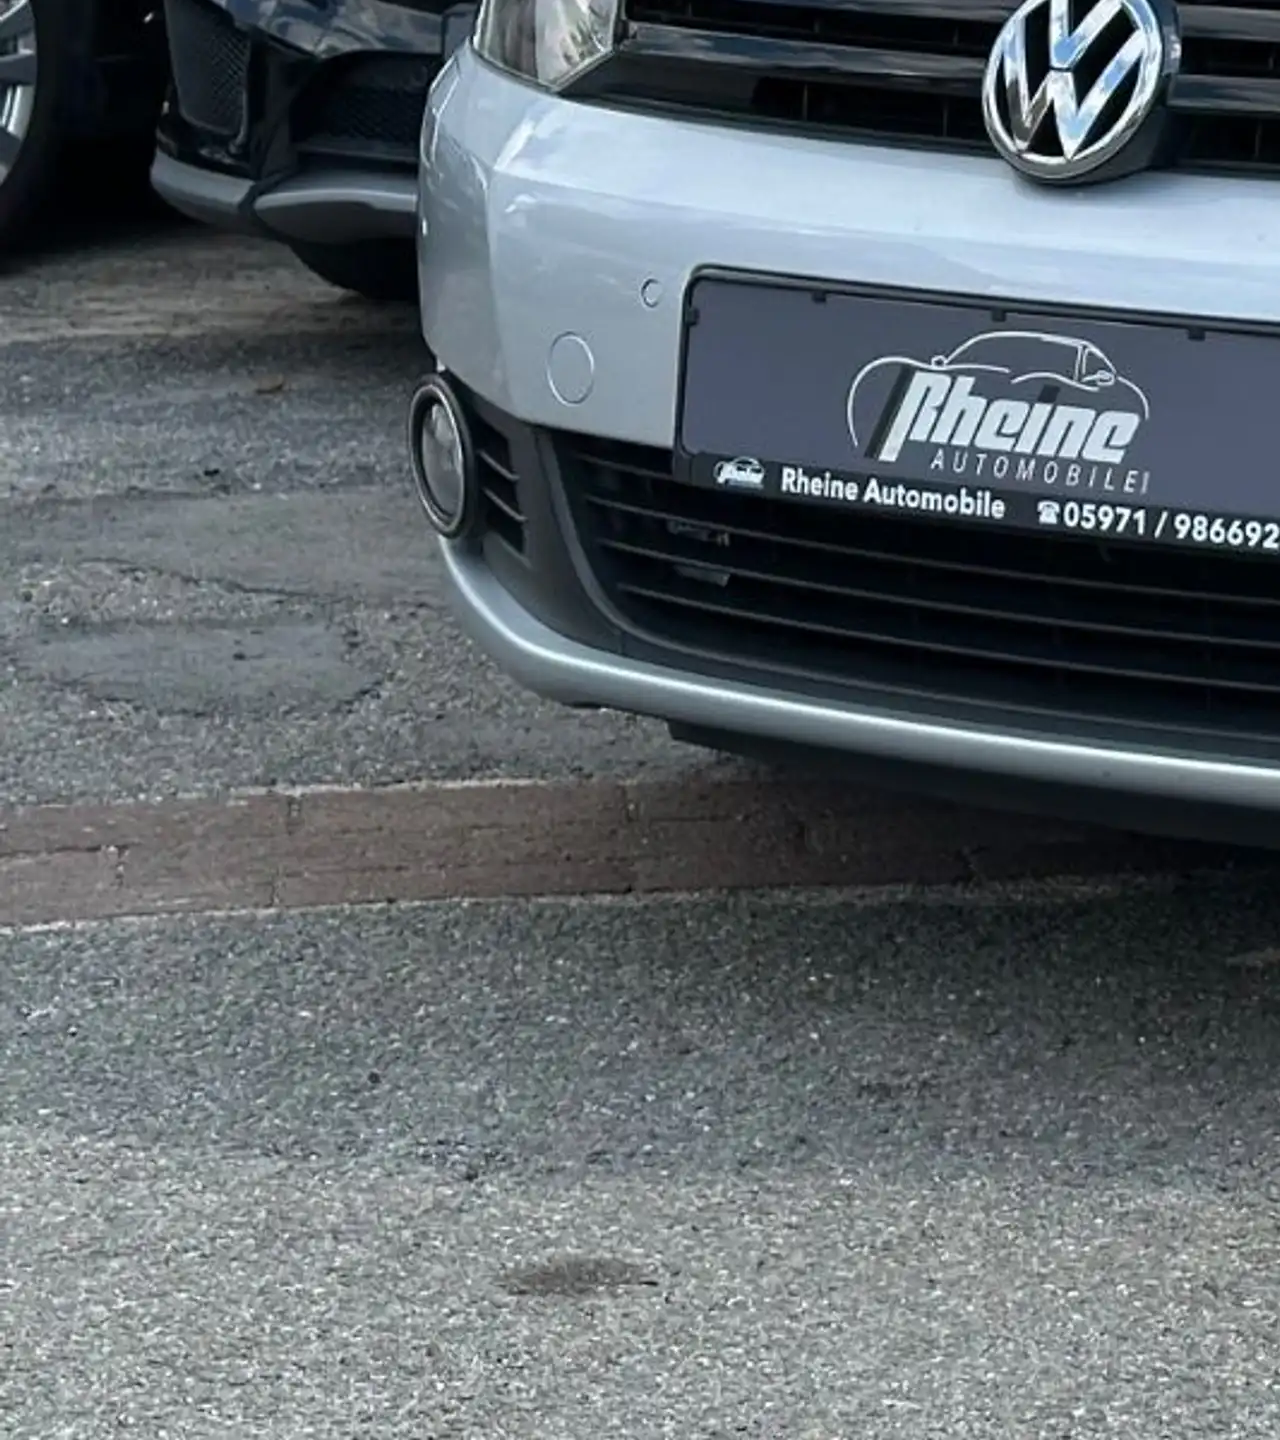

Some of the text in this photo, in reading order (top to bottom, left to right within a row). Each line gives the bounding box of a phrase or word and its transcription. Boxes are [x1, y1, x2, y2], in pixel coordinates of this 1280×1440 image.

[878, 370, 1141, 464] Rheine
[781, 466, 858, 501] Rheine
[863, 477, 1006, 519] Automobile
[1063, 501, 1147, 535] 05971
[1154, 511, 1168, 539] /
